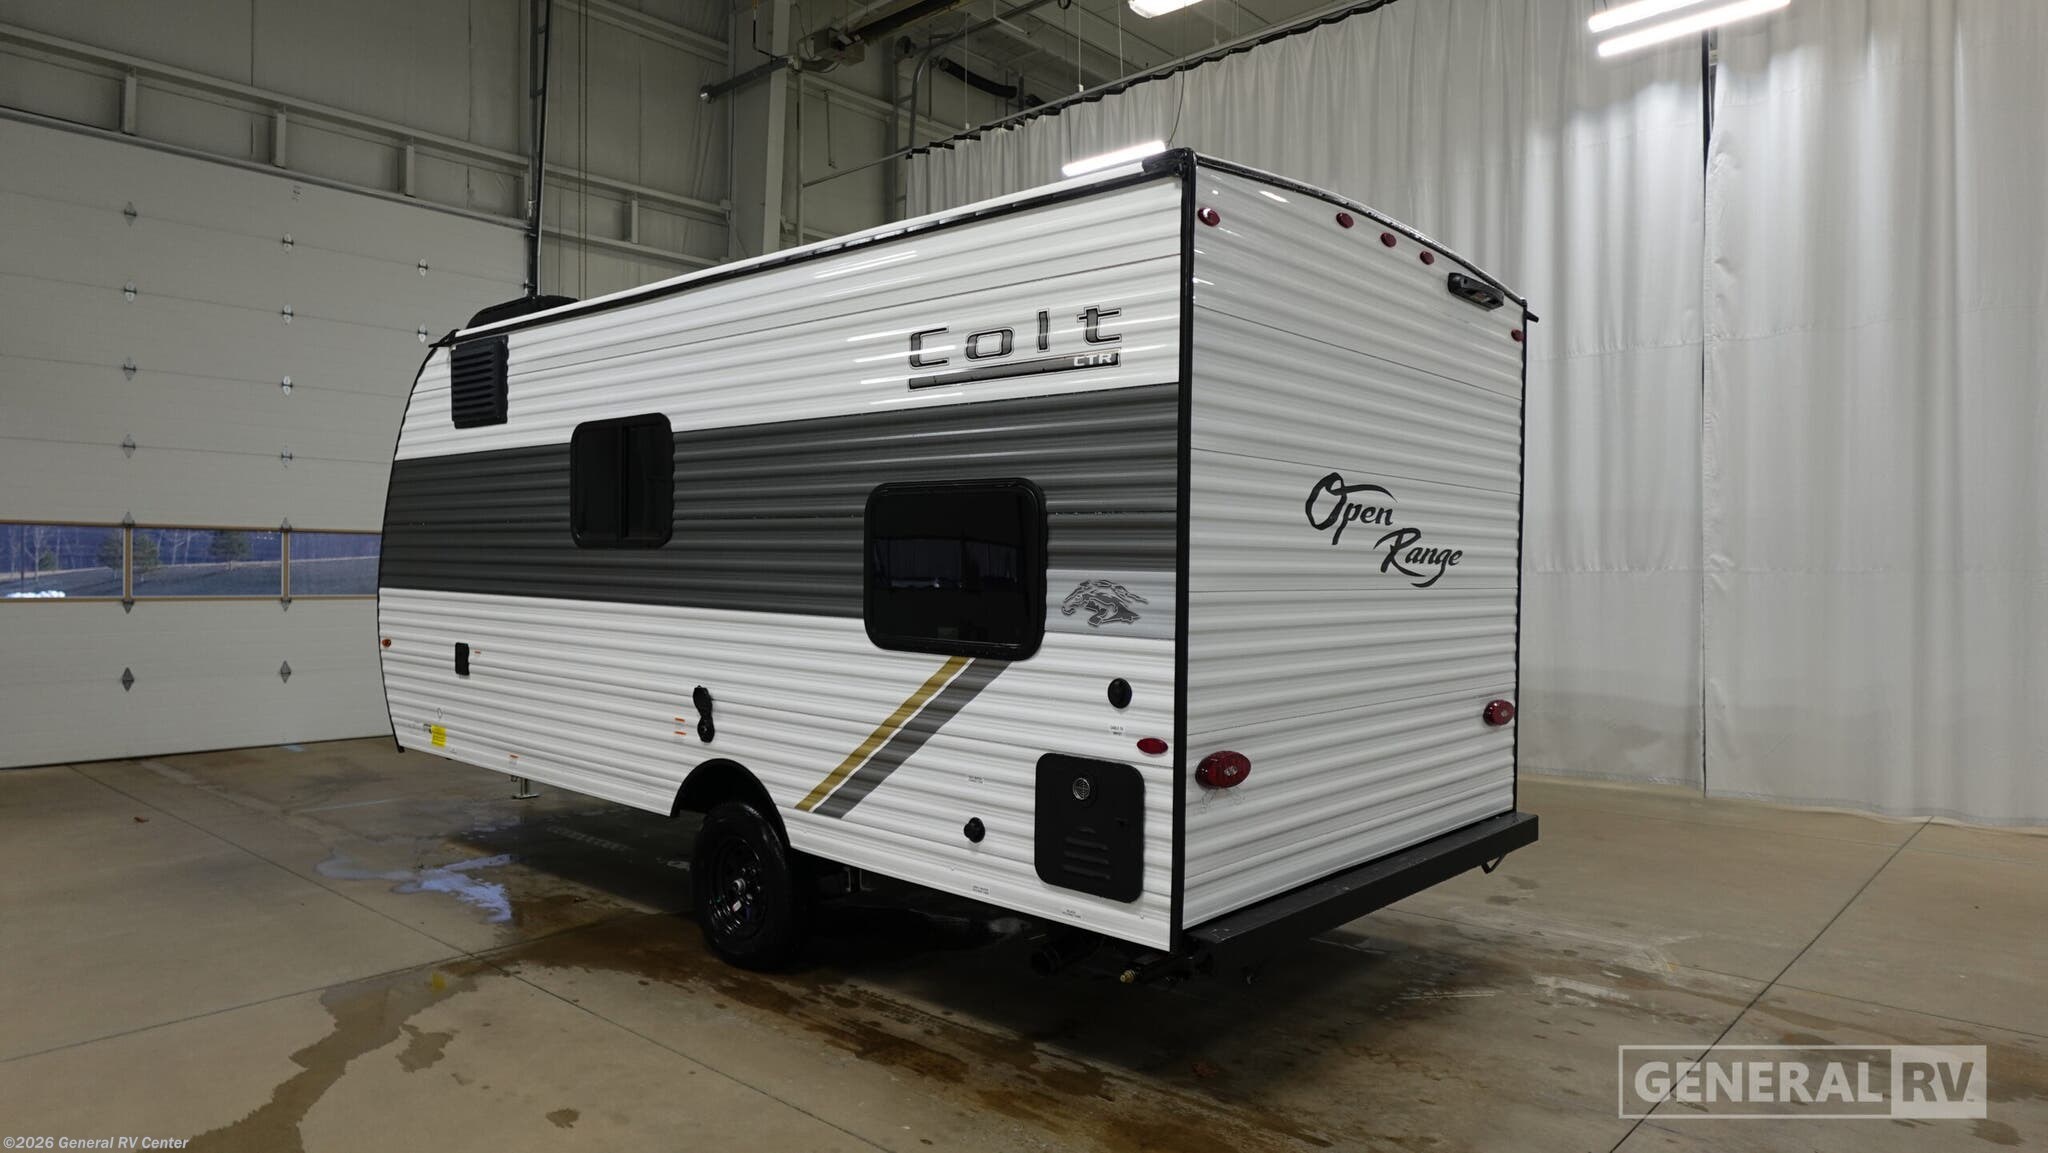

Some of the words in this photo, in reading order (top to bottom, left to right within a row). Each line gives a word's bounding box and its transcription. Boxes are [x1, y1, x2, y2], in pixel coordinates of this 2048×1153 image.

[909, 307, 1121, 369] Colt
[1073, 352, 1112, 367] CTR
[1305, 472, 1398, 545] Open
[1373, 527, 1463, 588] Range
